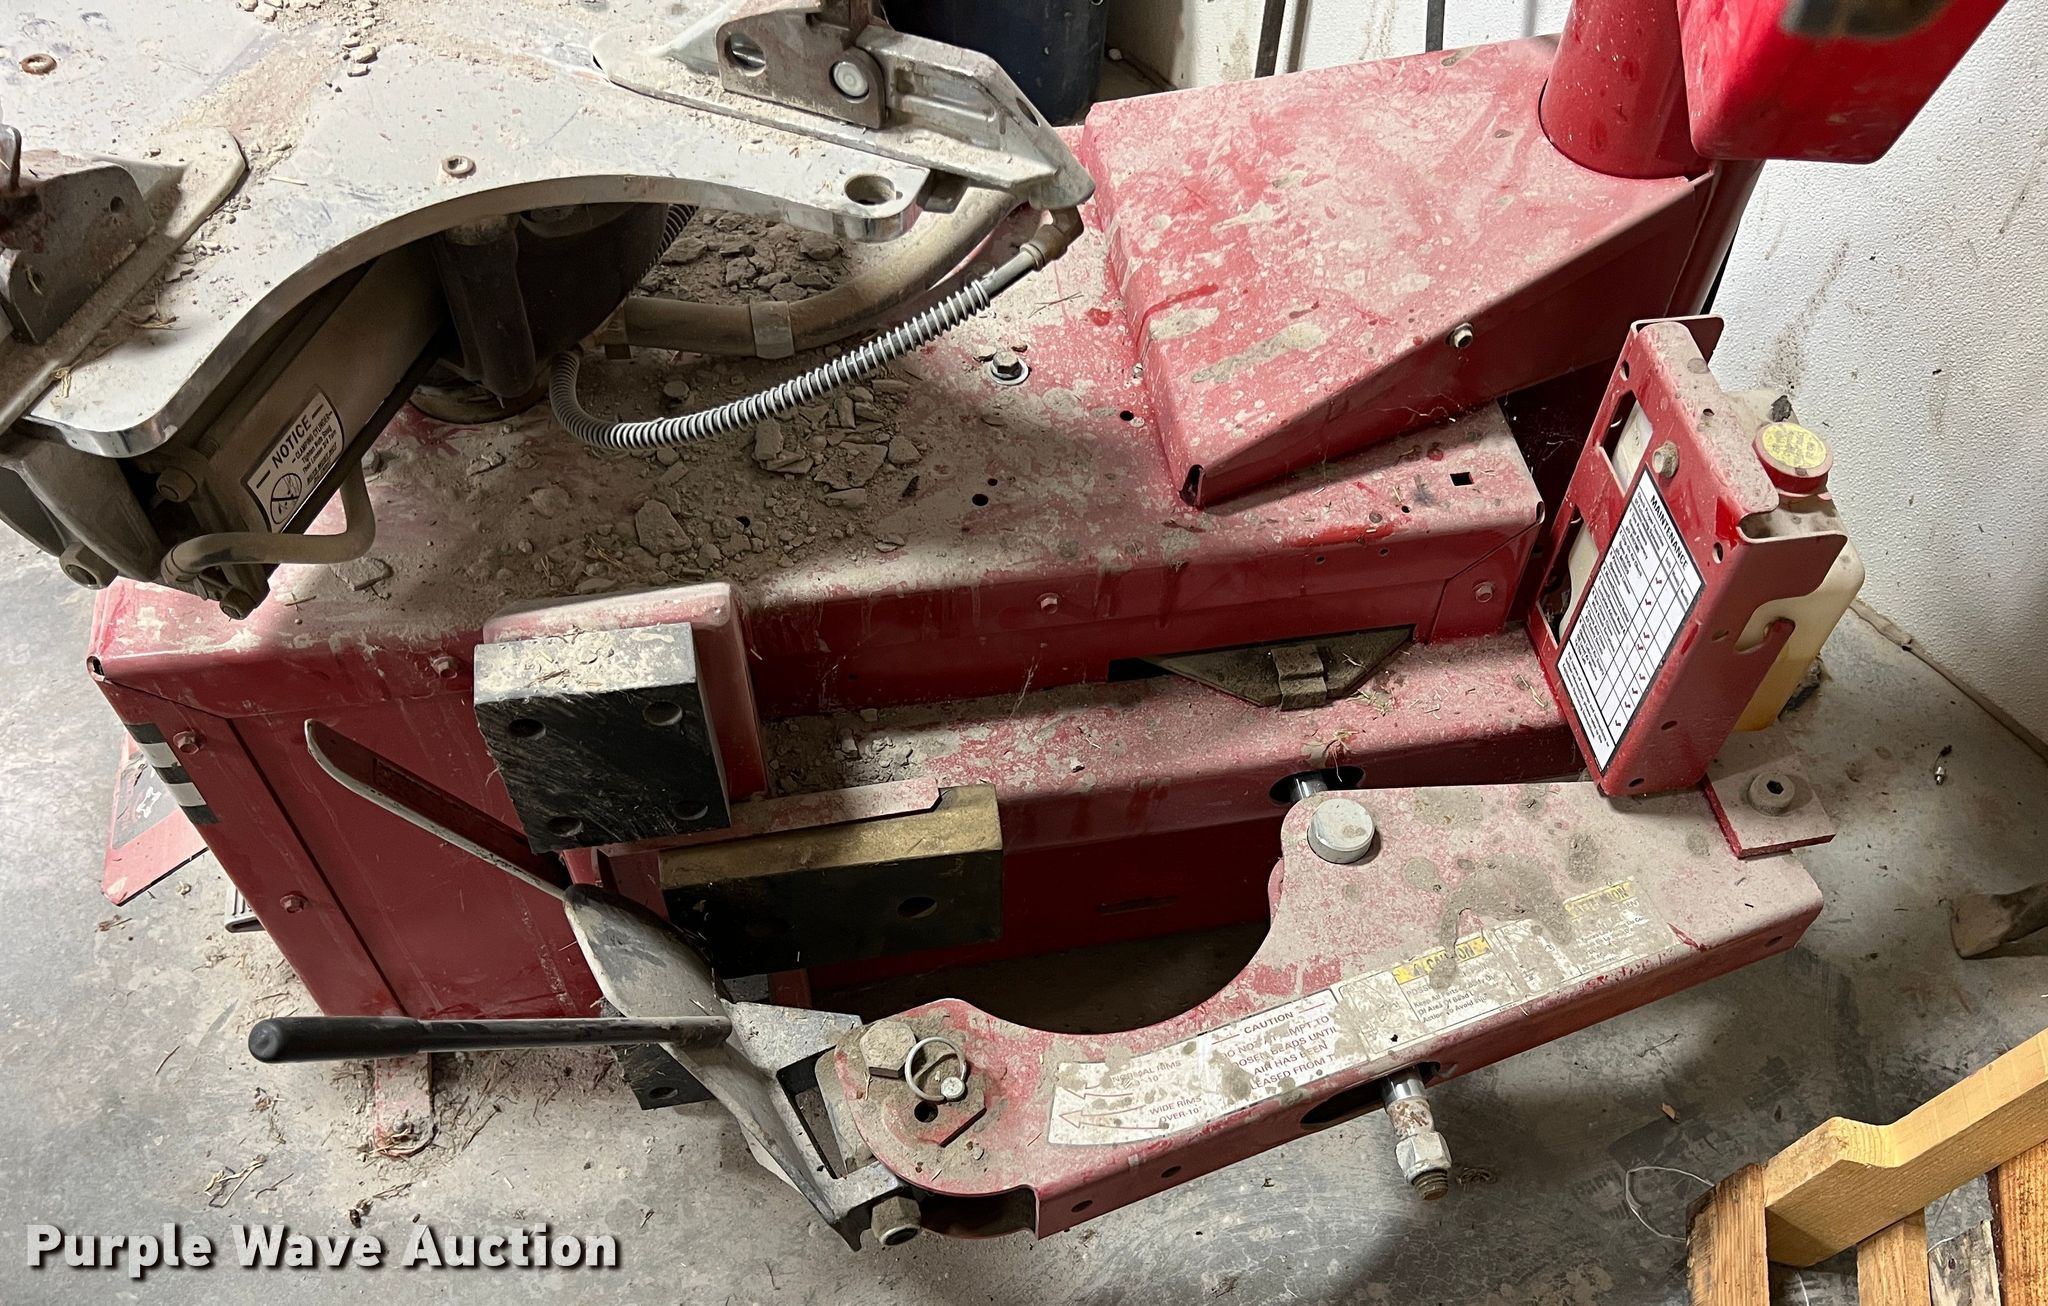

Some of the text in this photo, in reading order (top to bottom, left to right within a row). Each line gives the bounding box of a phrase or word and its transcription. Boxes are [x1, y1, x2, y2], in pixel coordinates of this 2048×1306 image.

[271, 414, 312, 469] NOTICE
[1650, 494, 1688, 571] MAINTENANCE
[1244, 1011, 1294, 1034] CAUTION
[1315, 1015, 1330, 1026] TO
[1251, 1058, 1326, 1090] LEASED FROM
[1253, 1062, 1273, 1075] AIR
[1275, 1054, 1298, 1068] HAS
[1150, 1097, 1202, 1115] WIDE RIMS
